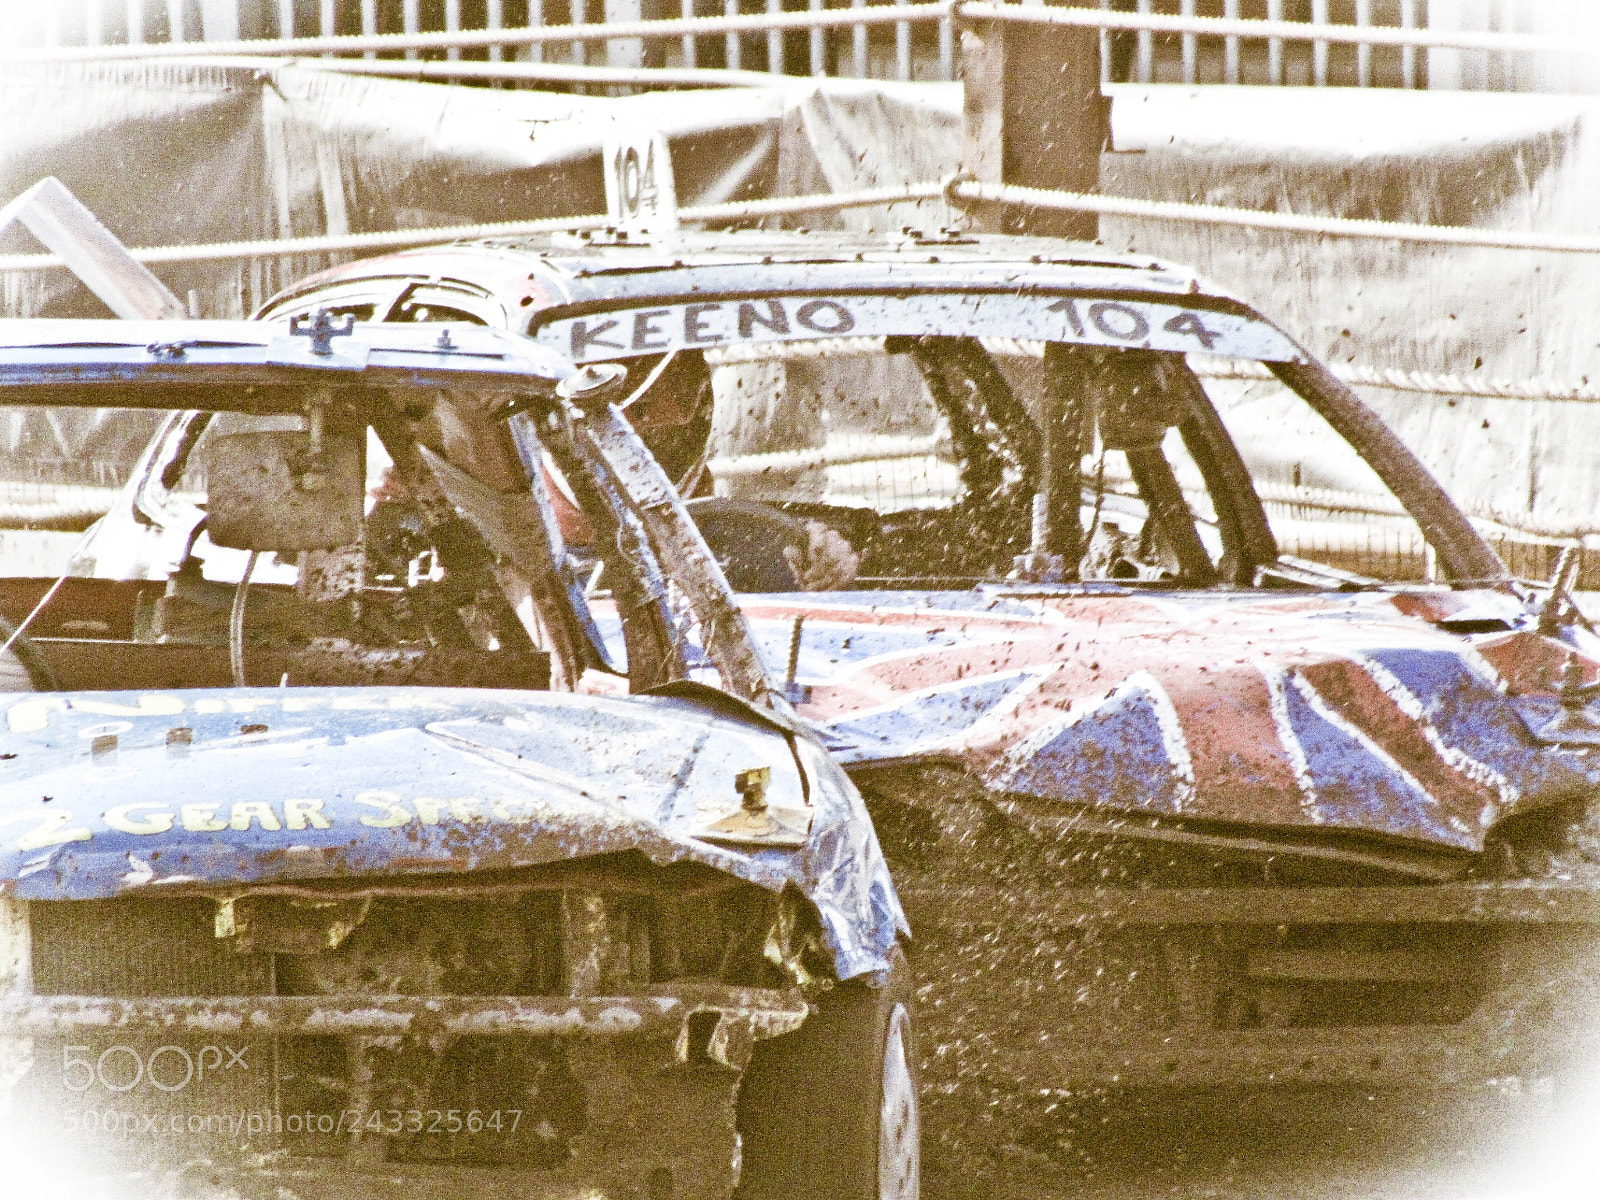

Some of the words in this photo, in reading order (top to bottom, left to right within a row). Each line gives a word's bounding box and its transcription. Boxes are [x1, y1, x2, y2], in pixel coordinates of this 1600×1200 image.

[613, 138, 658, 219] 104
[570, 299, 856, 358] KEENO
[1045, 298, 1223, 350] 104
[102, 799, 334, 835] GEAR
